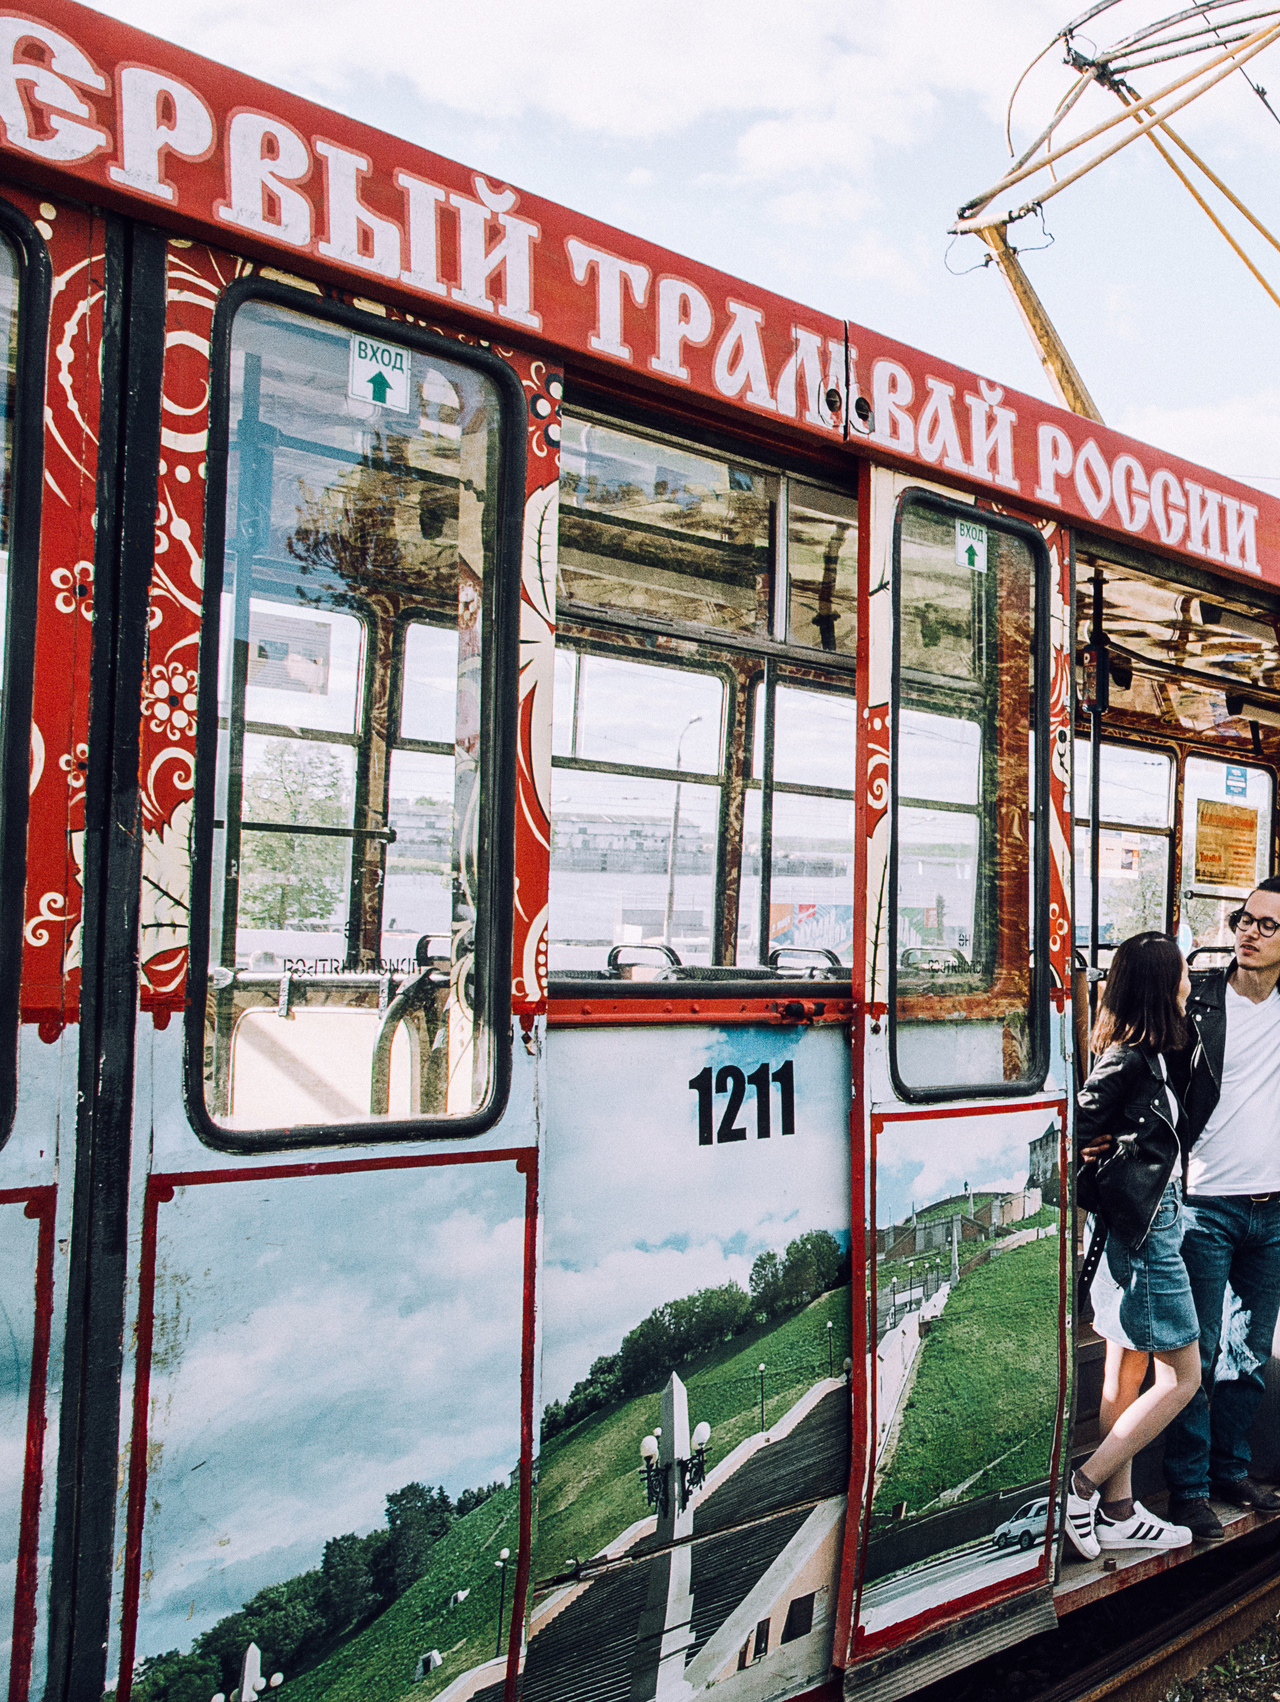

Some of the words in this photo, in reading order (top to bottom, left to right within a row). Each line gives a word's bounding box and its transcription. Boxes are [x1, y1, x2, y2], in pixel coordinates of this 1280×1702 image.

[357, 340, 404, 375] ВХОД
[566, 237, 1020, 491] ТРАМВАЙ
[1036, 426, 1261, 576] РОССИИ
[959, 522, 984, 545] ВХОД
[689, 1060, 795, 1146] 1211
